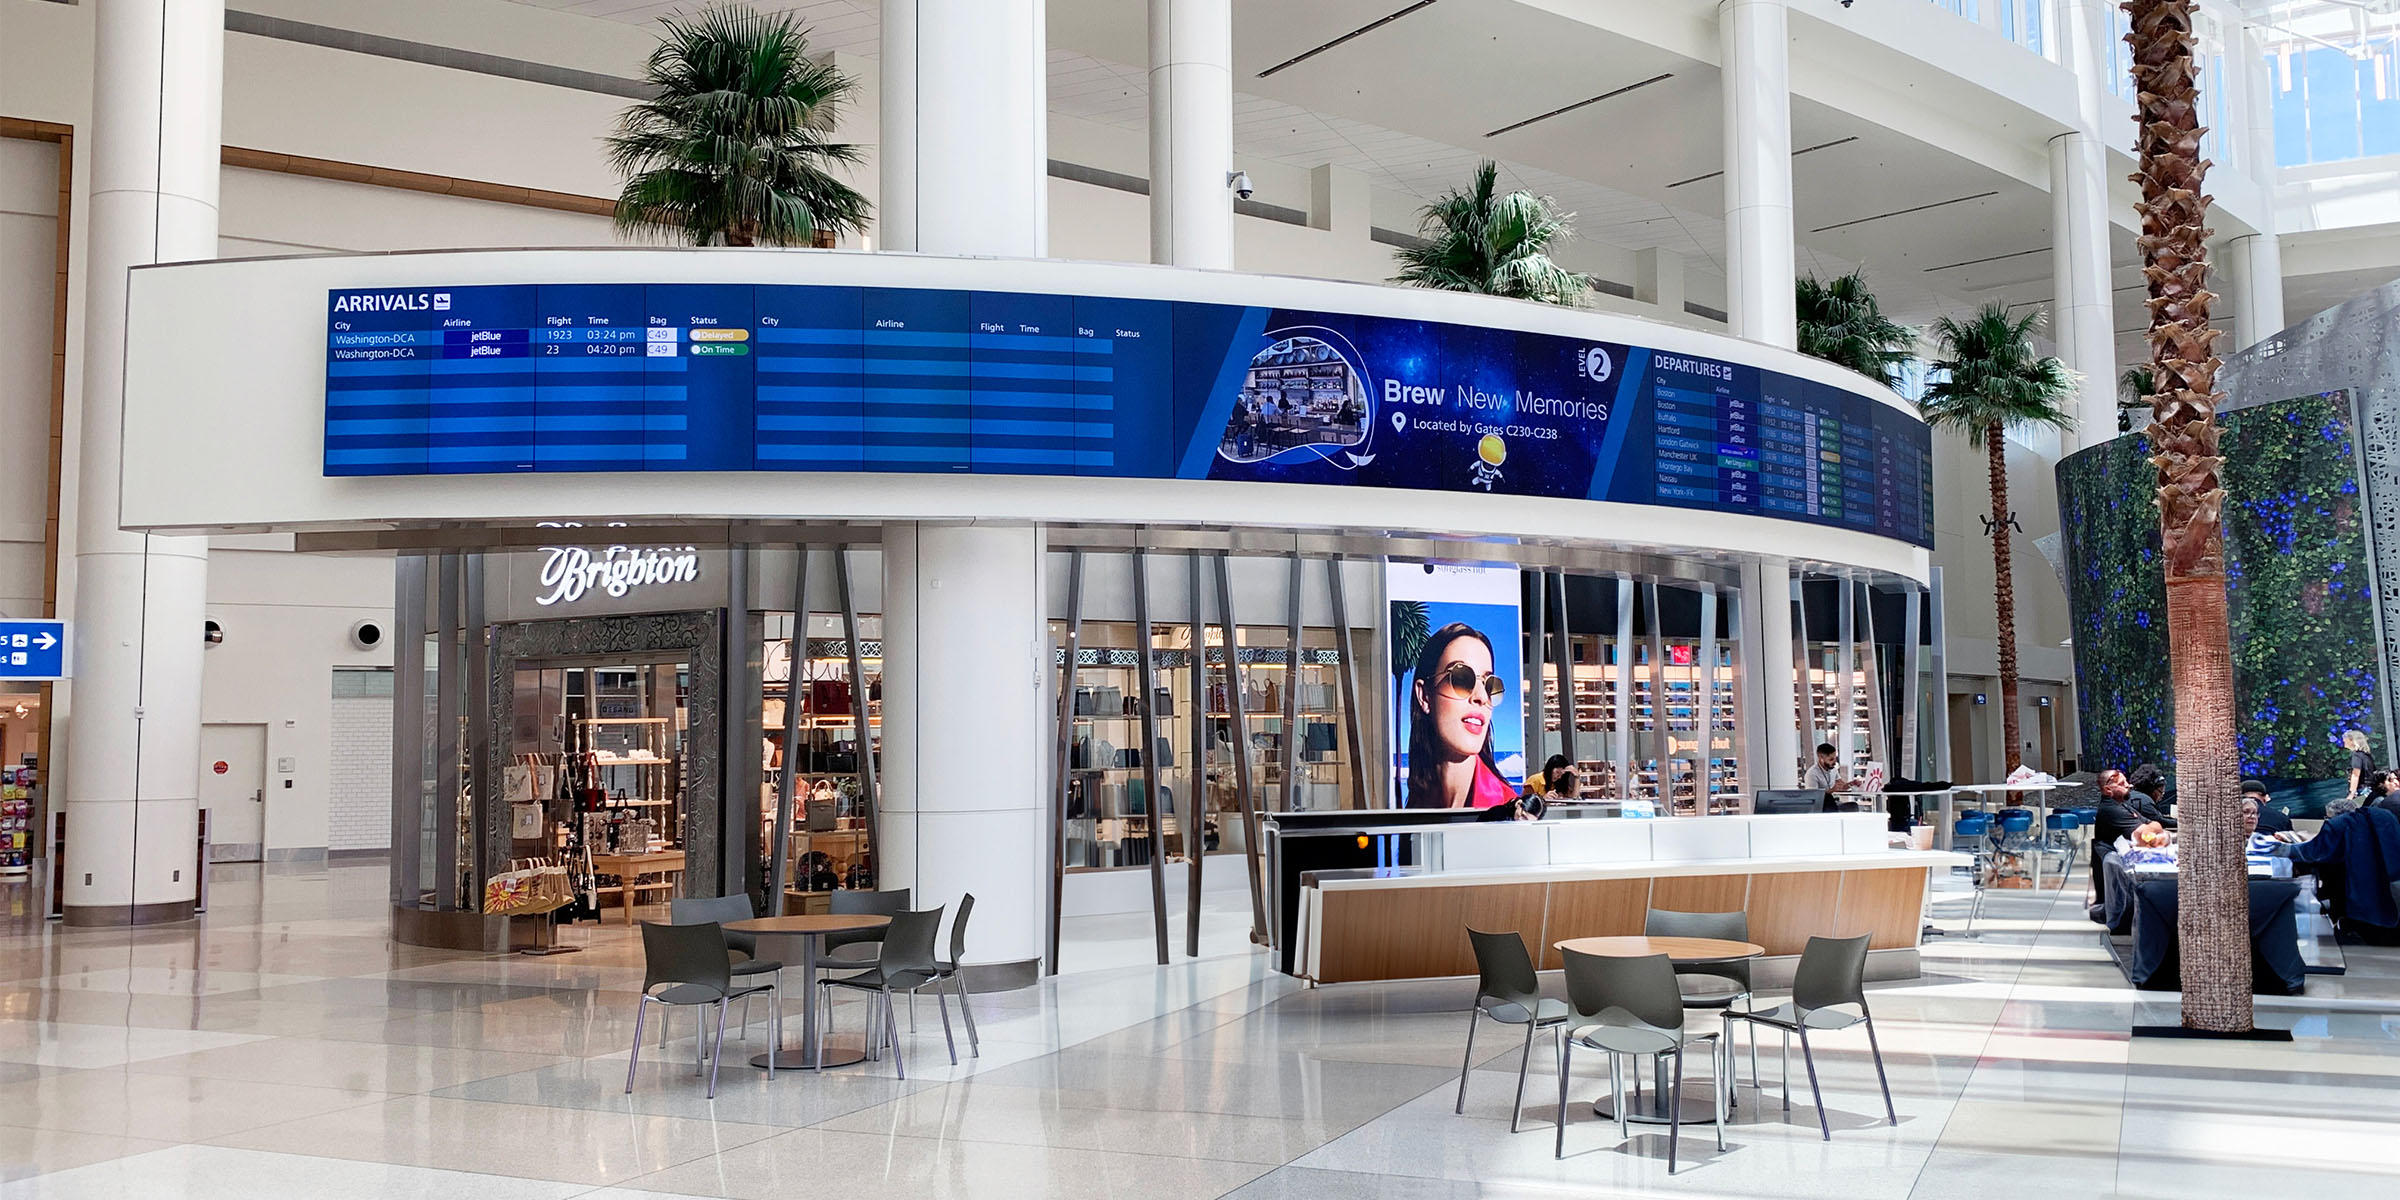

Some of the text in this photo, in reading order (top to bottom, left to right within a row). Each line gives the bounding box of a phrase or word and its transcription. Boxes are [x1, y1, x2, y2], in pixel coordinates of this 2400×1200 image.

[334, 294, 429, 312] ARRIVALS
[334, 317, 718, 331] City Airline Flight Time Bag Status
[762, 317, 1140, 338] City Airline Flight Time Bag Status
[336, 330, 734, 346] Washington-DCA jetBlue 1923 03:24 pm C49 Delayed
[335, 345, 734, 360] Washington-DCA jetBlue 23 04:20 pm C49 On Time
[1578, 347, 1605, 377] LEVEL 2
[1655, 355, 1721, 378] DEPARTURES
[1384, 379, 1608, 421] Brew New Memories
[1413, 418, 1558, 440] Located by Gates C230-C238
[535, 548, 699, 606] Brighton
